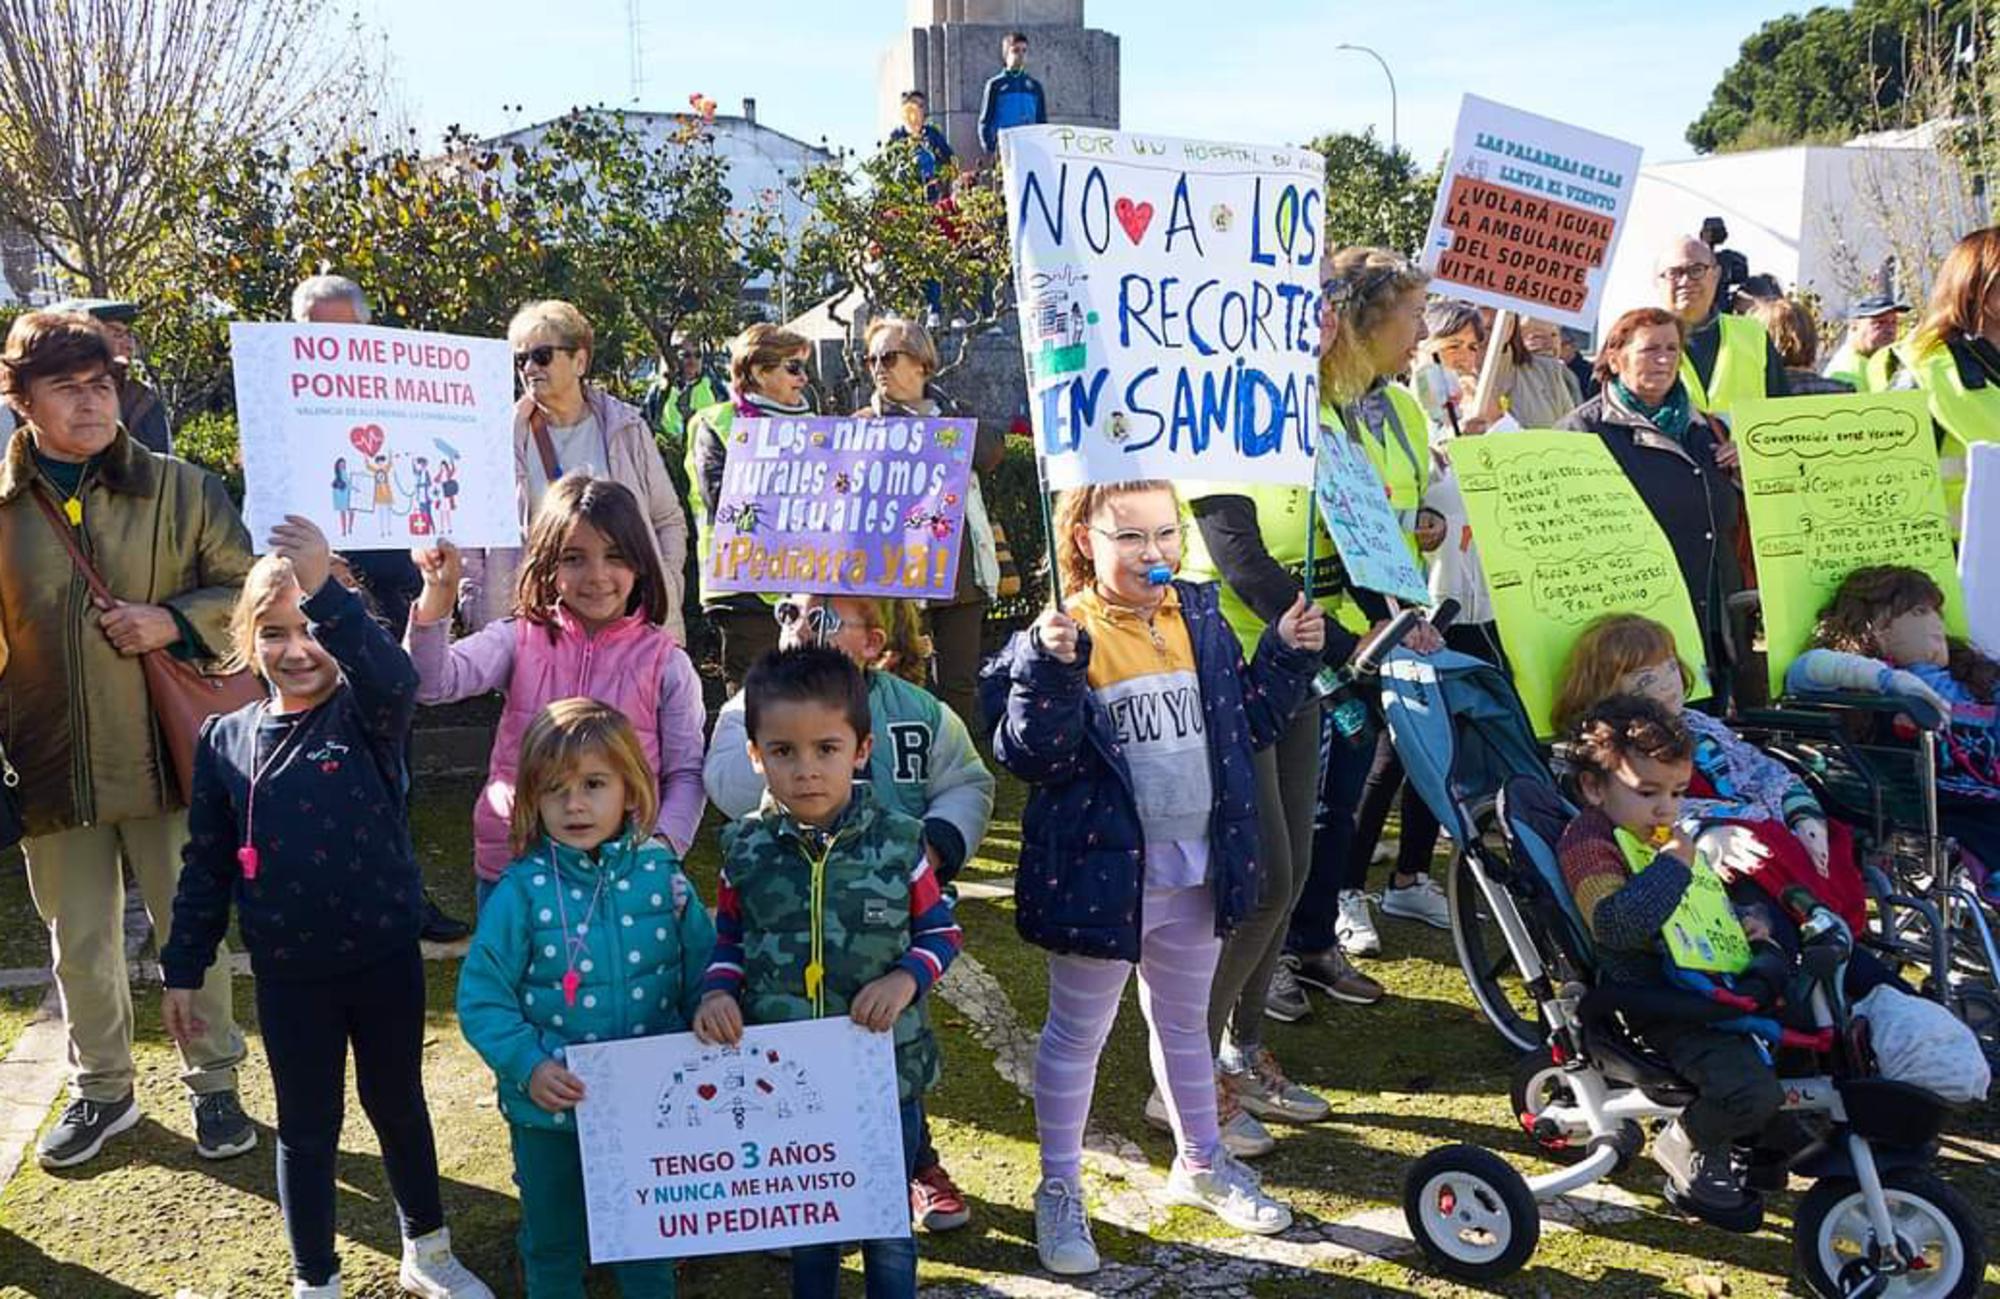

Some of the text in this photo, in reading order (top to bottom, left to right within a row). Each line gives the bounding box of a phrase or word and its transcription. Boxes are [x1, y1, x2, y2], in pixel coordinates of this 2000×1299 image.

[1048, 127, 1115, 154] POR
[1474, 132, 1504, 153] LAS
[1506, 140, 1579, 175] PALABRAS
[1499, 164, 1617, 211] LLEVA EL VIENTO
[1018, 163, 1321, 266] NO A LOS
[1458, 185, 1610, 240] ¿VOLARÁ IGUAL
[1446, 207, 1603, 265] LA AMBULANCIA
[1453, 235, 1587, 285] DEL SOPORTE
[1439, 257, 1585, 309] VITAL BÁSICO?
[294, 336, 470, 371] NO ME PUEDO
[292, 373, 476, 407] PONER MALITA
[1039, 368, 1110, 455] EN
[731, 460, 946, 497] rurales somos
[887, 721, 933, 783] R
[651, 1140, 837, 1178] TENGO 3 AÑOS
[636, 1170, 856, 1205] Y NUNCA ME HA VISTO
[658, 1200, 840, 1239] UN PEDIATRA
